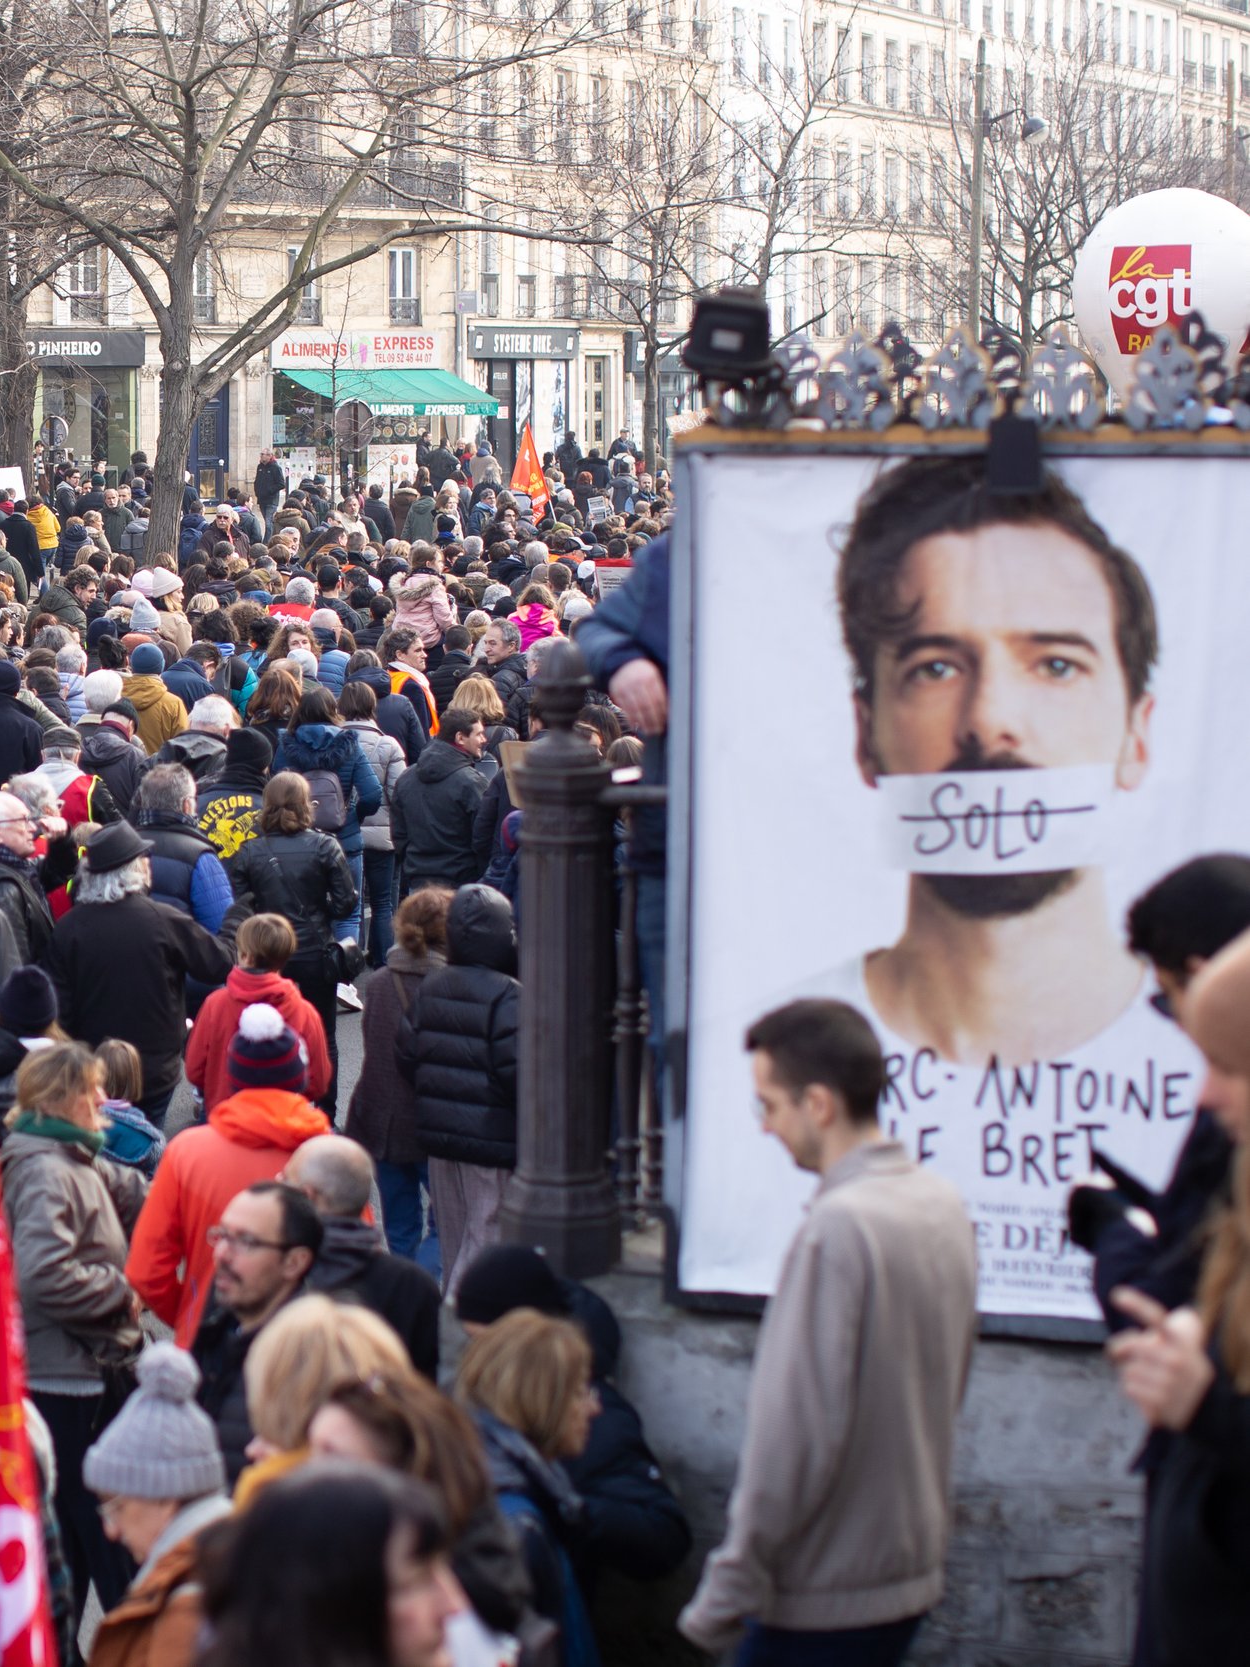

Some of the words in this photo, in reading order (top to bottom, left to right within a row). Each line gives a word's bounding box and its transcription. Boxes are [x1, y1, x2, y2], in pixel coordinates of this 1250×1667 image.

[1111, 246, 1180, 282] la
[1107, 268, 1196, 328] cgt
[38, 340, 102, 356] PINHEIRO
[281, 343, 348, 357] ALIMENTS
[373, 336, 434, 350] EXPRESS
[533, 334, 552, 353] BIKE
[374, 353, 387, 363] TEL
[387, 353, 396, 363] 09
[397, 353, 405, 363] 52
[406, 353, 415, 363] 46
[416, 353, 424, 363] 44
[424, 353, 433, 363] 07
[424, 404, 465, 416] EXPRESS
[981, 1121, 1108, 1187] BRET
[1002, 1219, 1078, 1261] DÉJ
